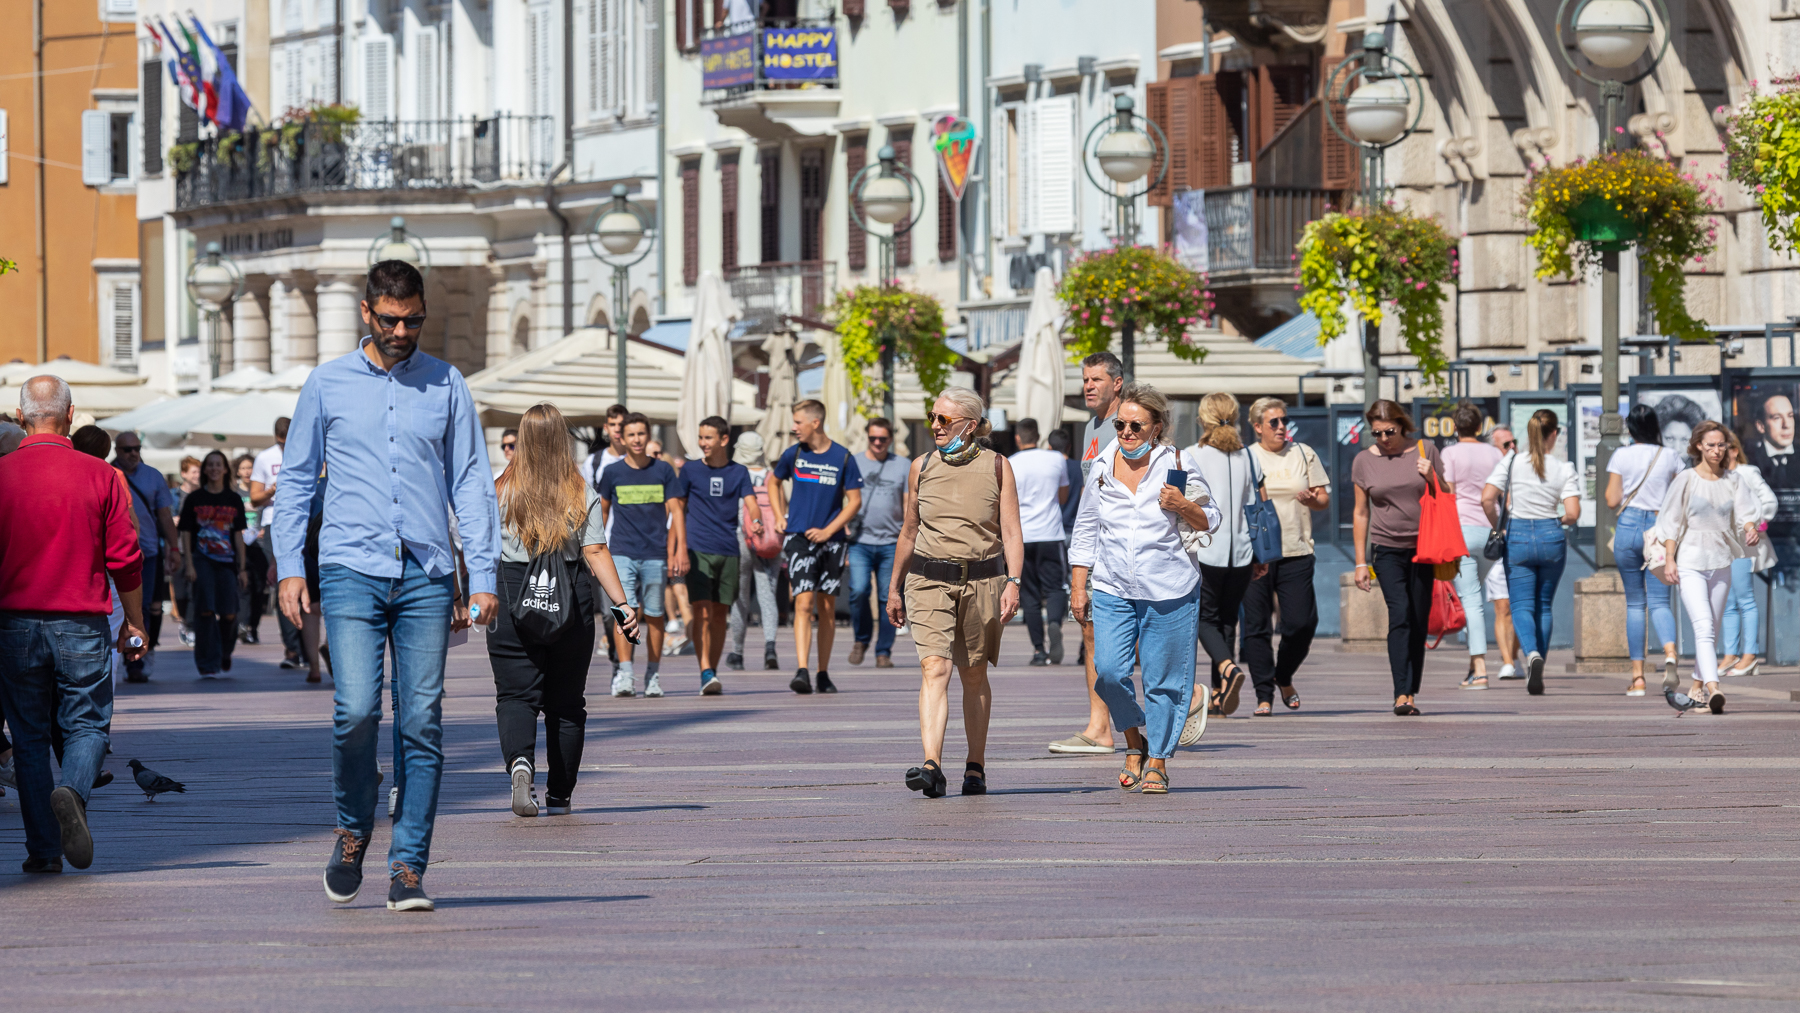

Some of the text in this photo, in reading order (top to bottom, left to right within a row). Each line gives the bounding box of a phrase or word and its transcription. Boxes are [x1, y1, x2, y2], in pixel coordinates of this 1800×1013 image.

[767, 32, 833, 49] HAPPY
[764, 53, 837, 68] HOSTEL
[795, 458, 839, 472] Champion
[522, 598, 560, 612] adidas
